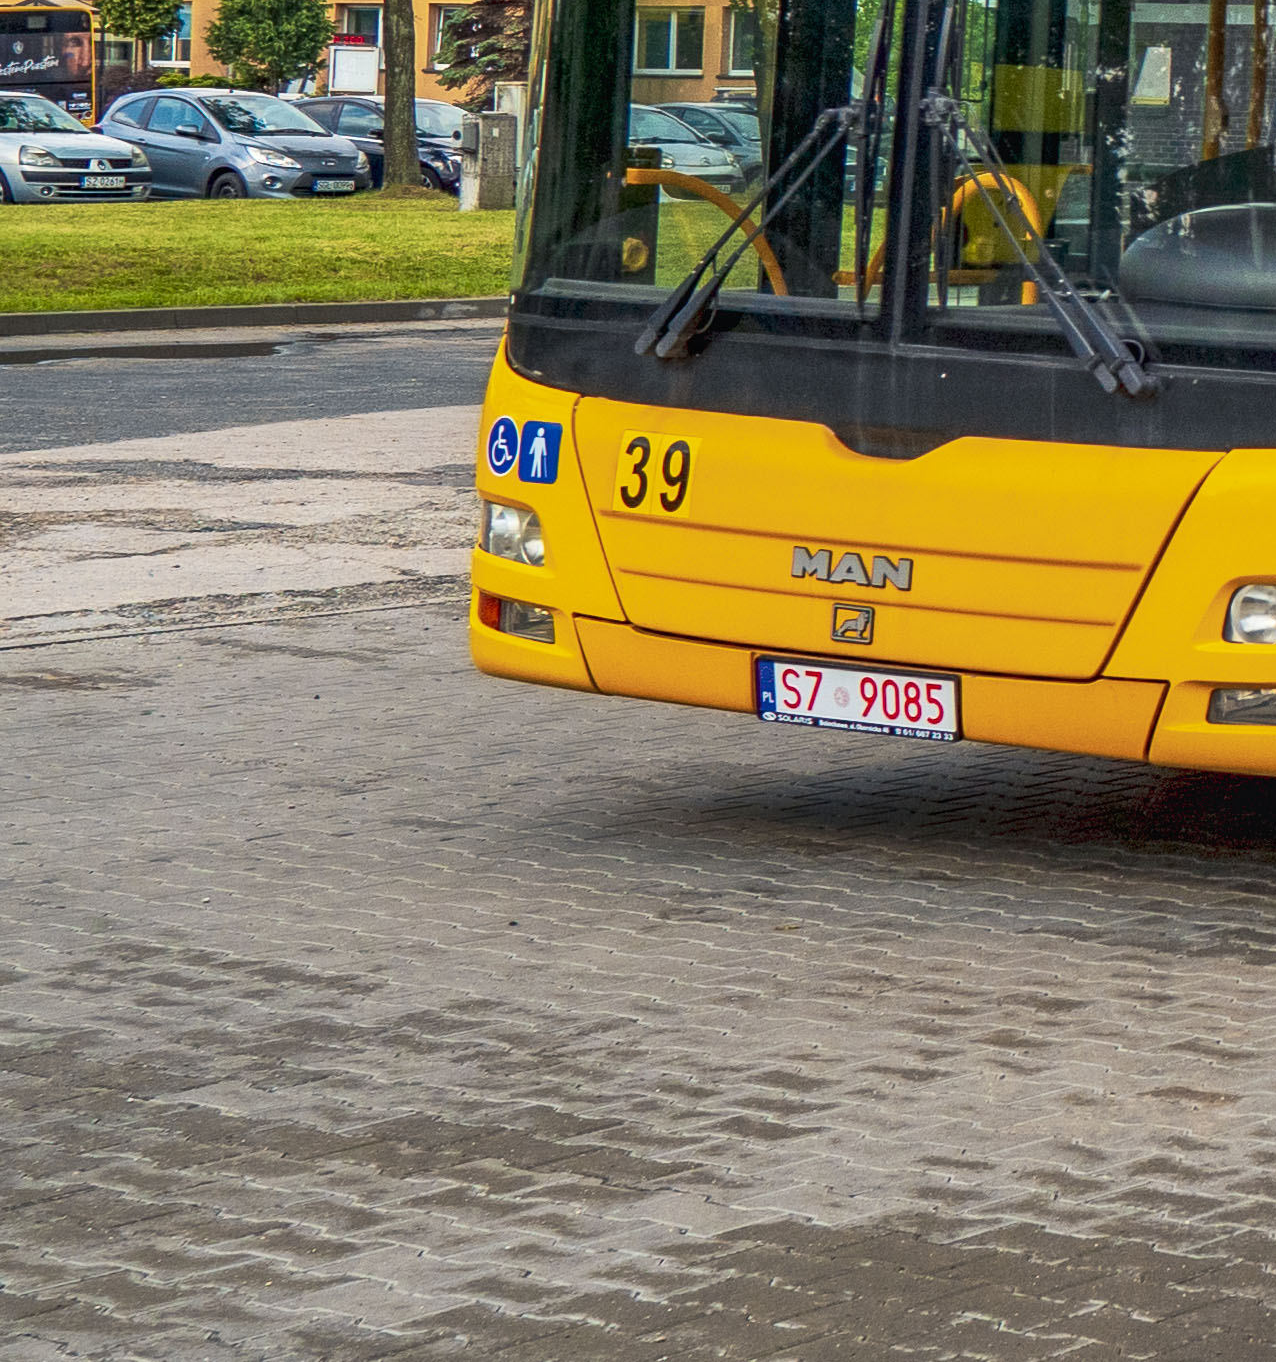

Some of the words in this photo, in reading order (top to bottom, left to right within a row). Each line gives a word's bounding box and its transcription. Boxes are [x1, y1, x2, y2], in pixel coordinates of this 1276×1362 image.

[620, 435, 692, 513] 39
[791, 546, 914, 591] MAN
[762, 691, 774, 704] PL
[777, 712, 813, 725] SOLARIS
[781, 668, 823, 711] S7
[859, 676, 945, 725] 9085
